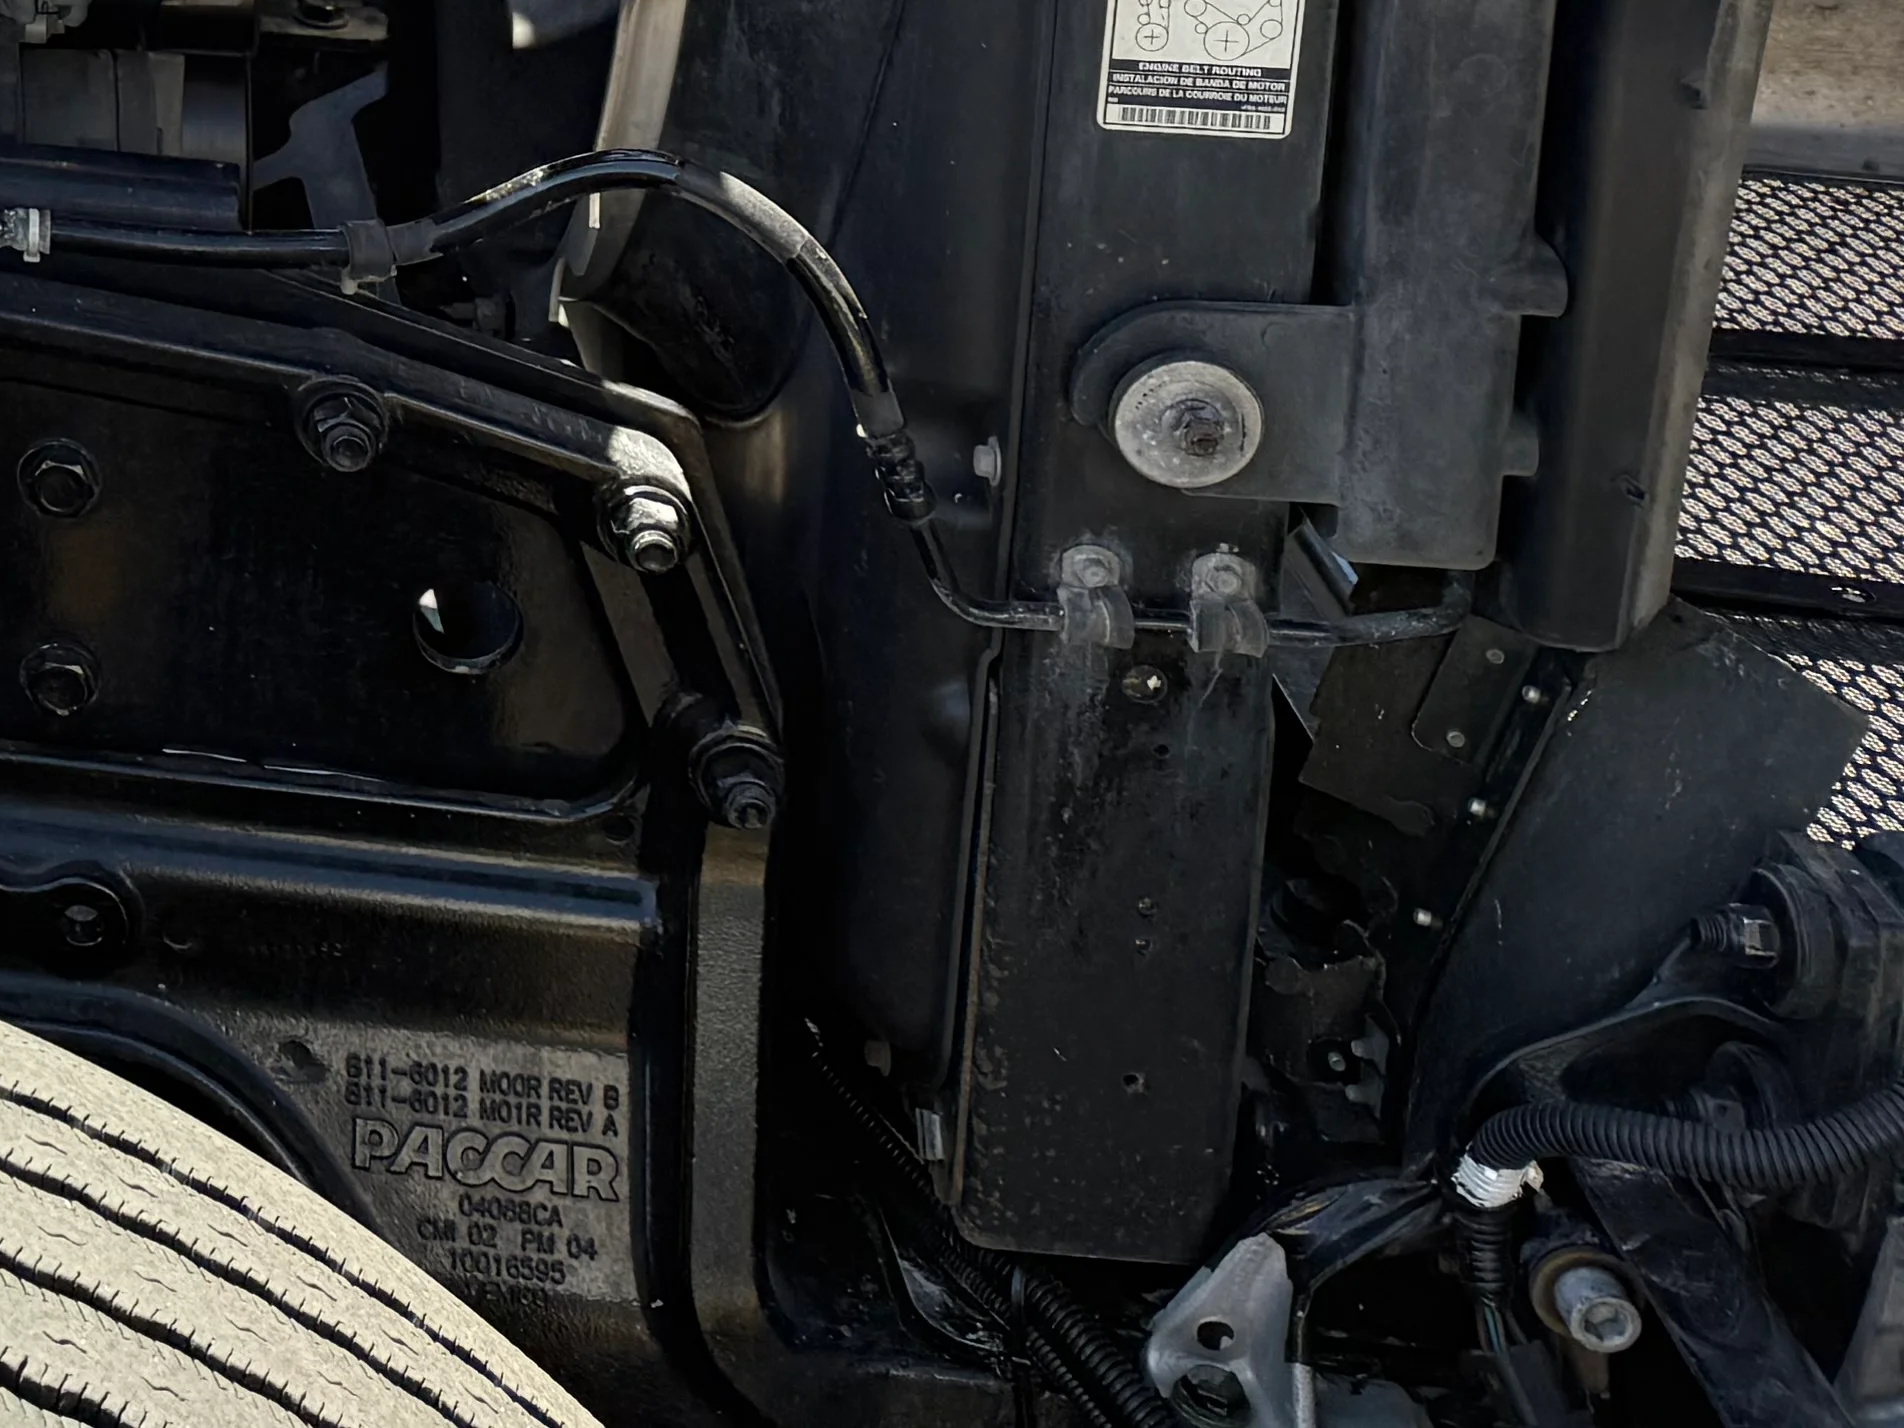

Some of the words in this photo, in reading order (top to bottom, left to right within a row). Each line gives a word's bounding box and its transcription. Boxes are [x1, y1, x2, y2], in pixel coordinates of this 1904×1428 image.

[1138, 61, 1180, 72] ENGINE
[1181, 64, 1209, 74] BELT
[1211, 66, 1262, 77] ROUTING
[352, 1114, 621, 1204] PACCAR
